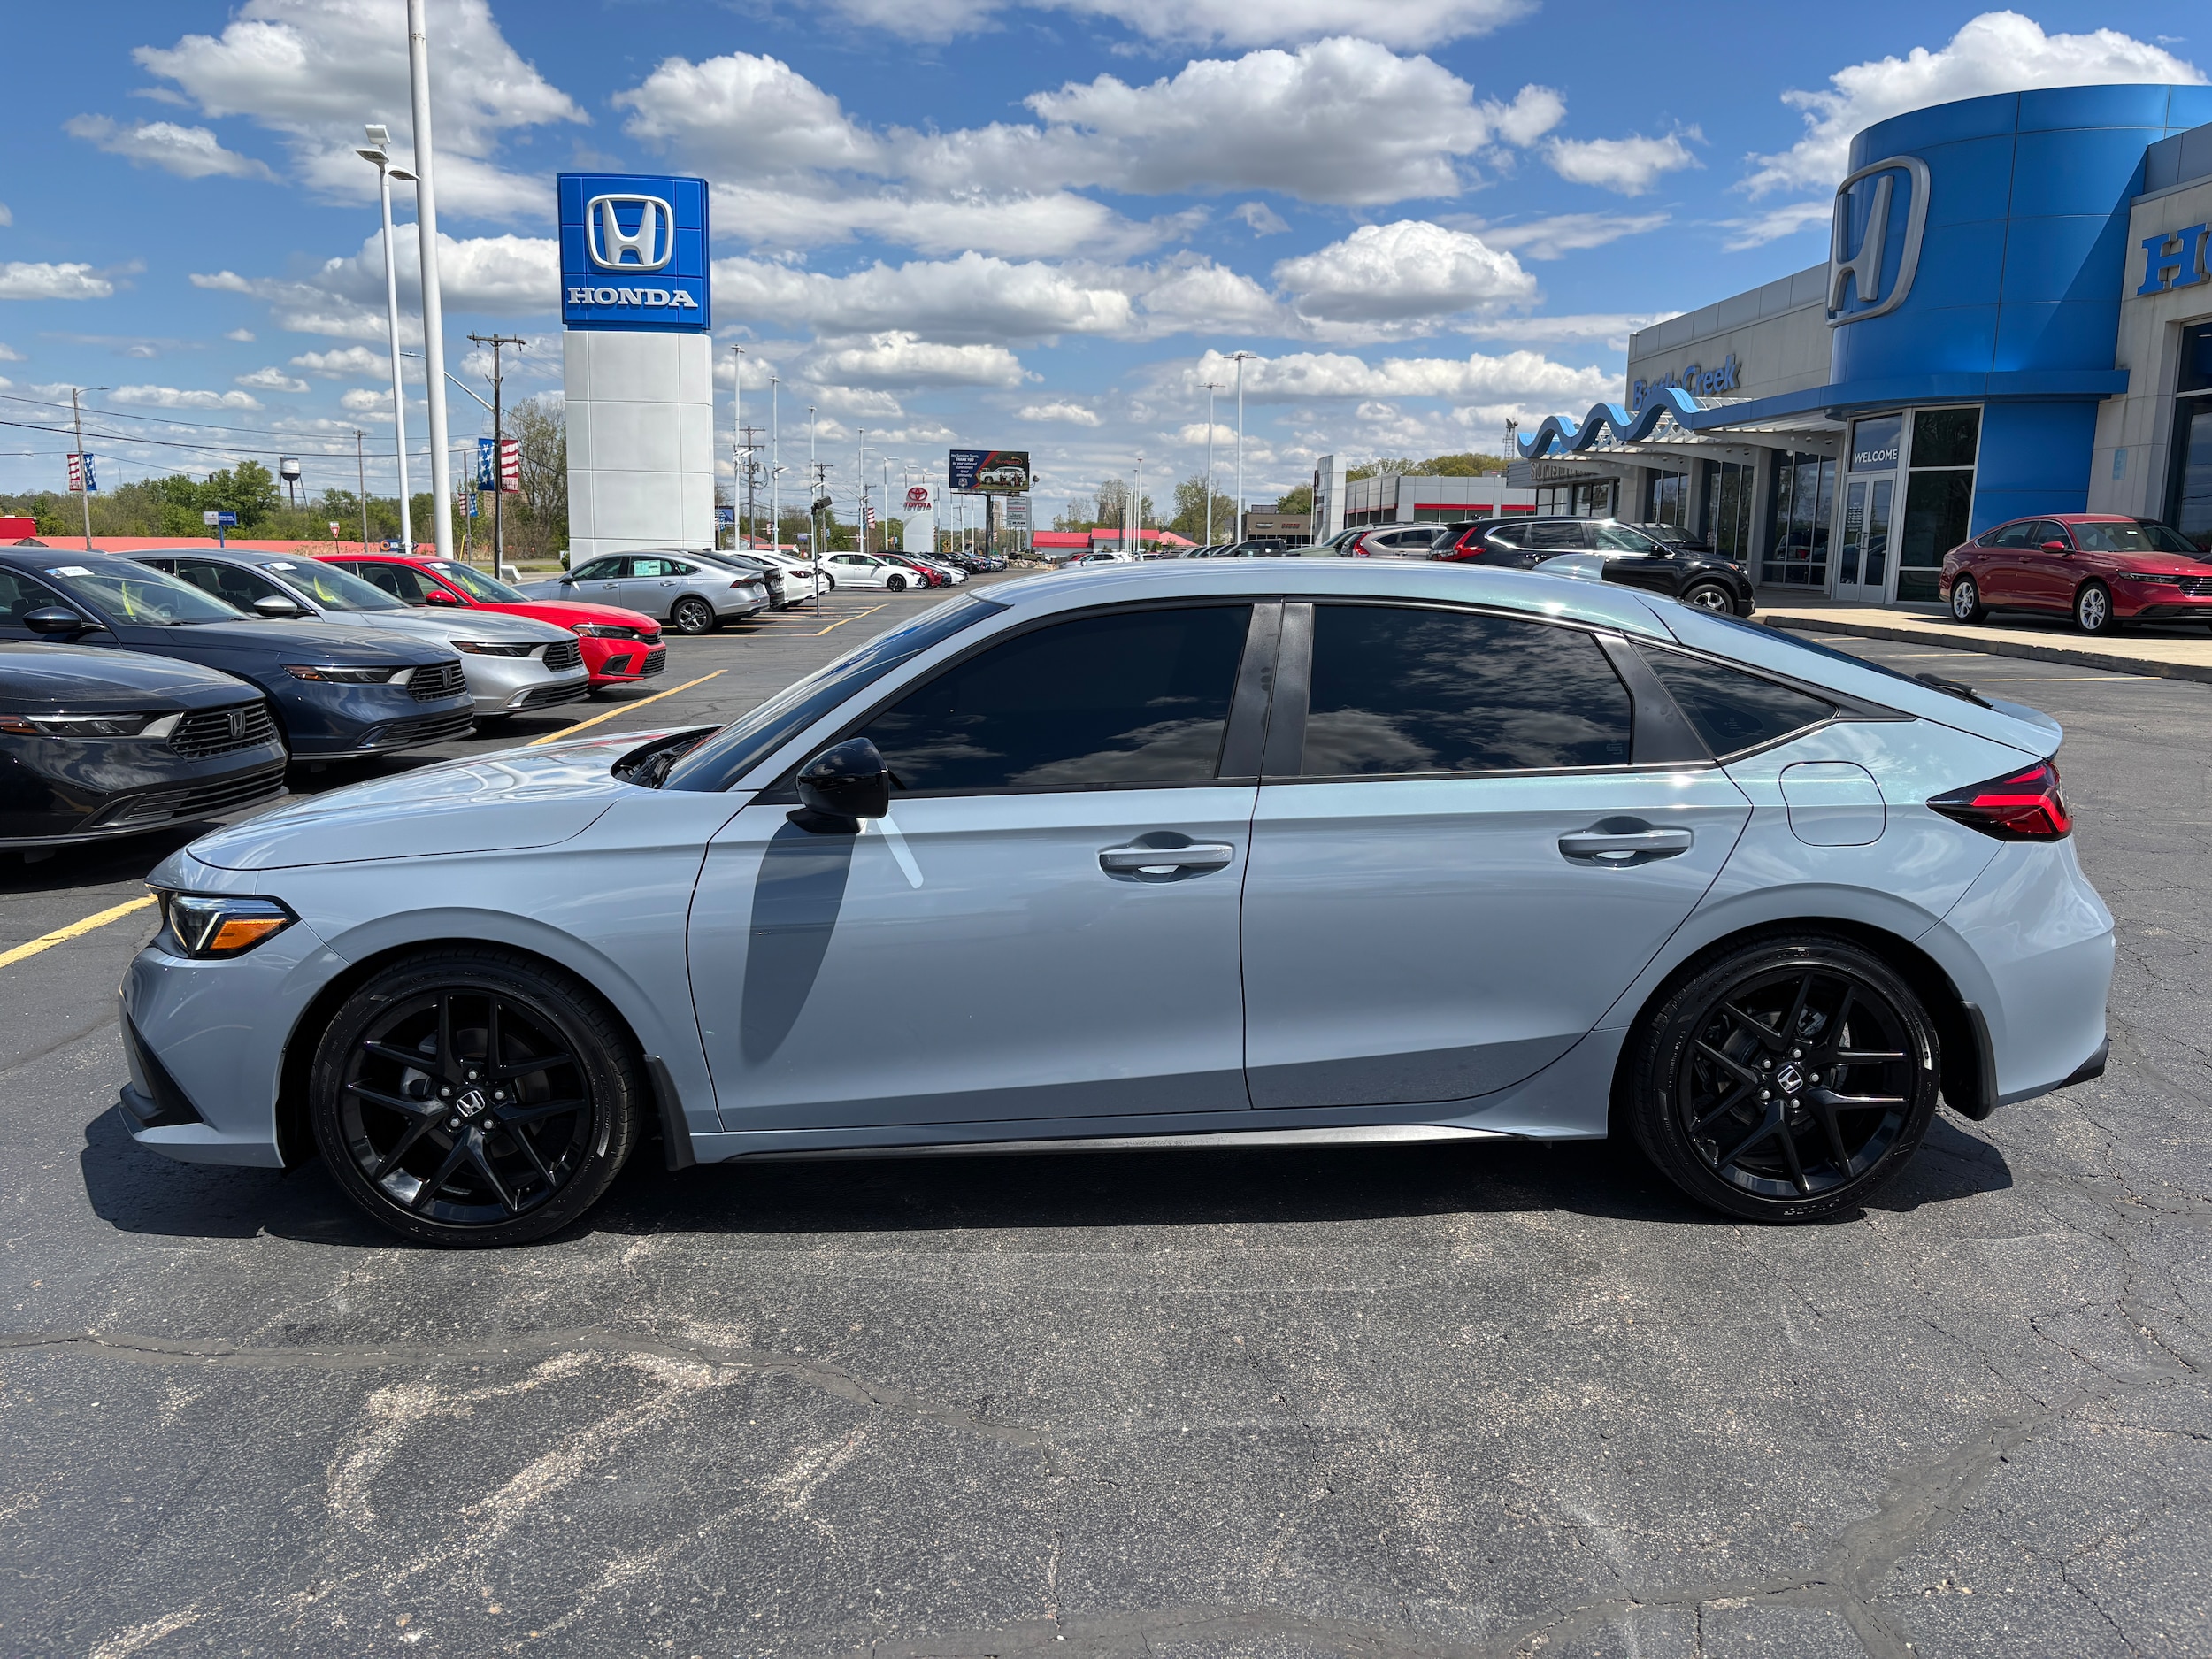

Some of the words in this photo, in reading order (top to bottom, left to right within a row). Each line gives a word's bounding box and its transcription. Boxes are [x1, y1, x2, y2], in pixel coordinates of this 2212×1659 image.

[2137, 223, 2212, 296] H
[567, 288, 698, 308] HONDA
[1682, 354, 1740, 396] Creek
[1854, 449, 1897, 464] WELCOME
